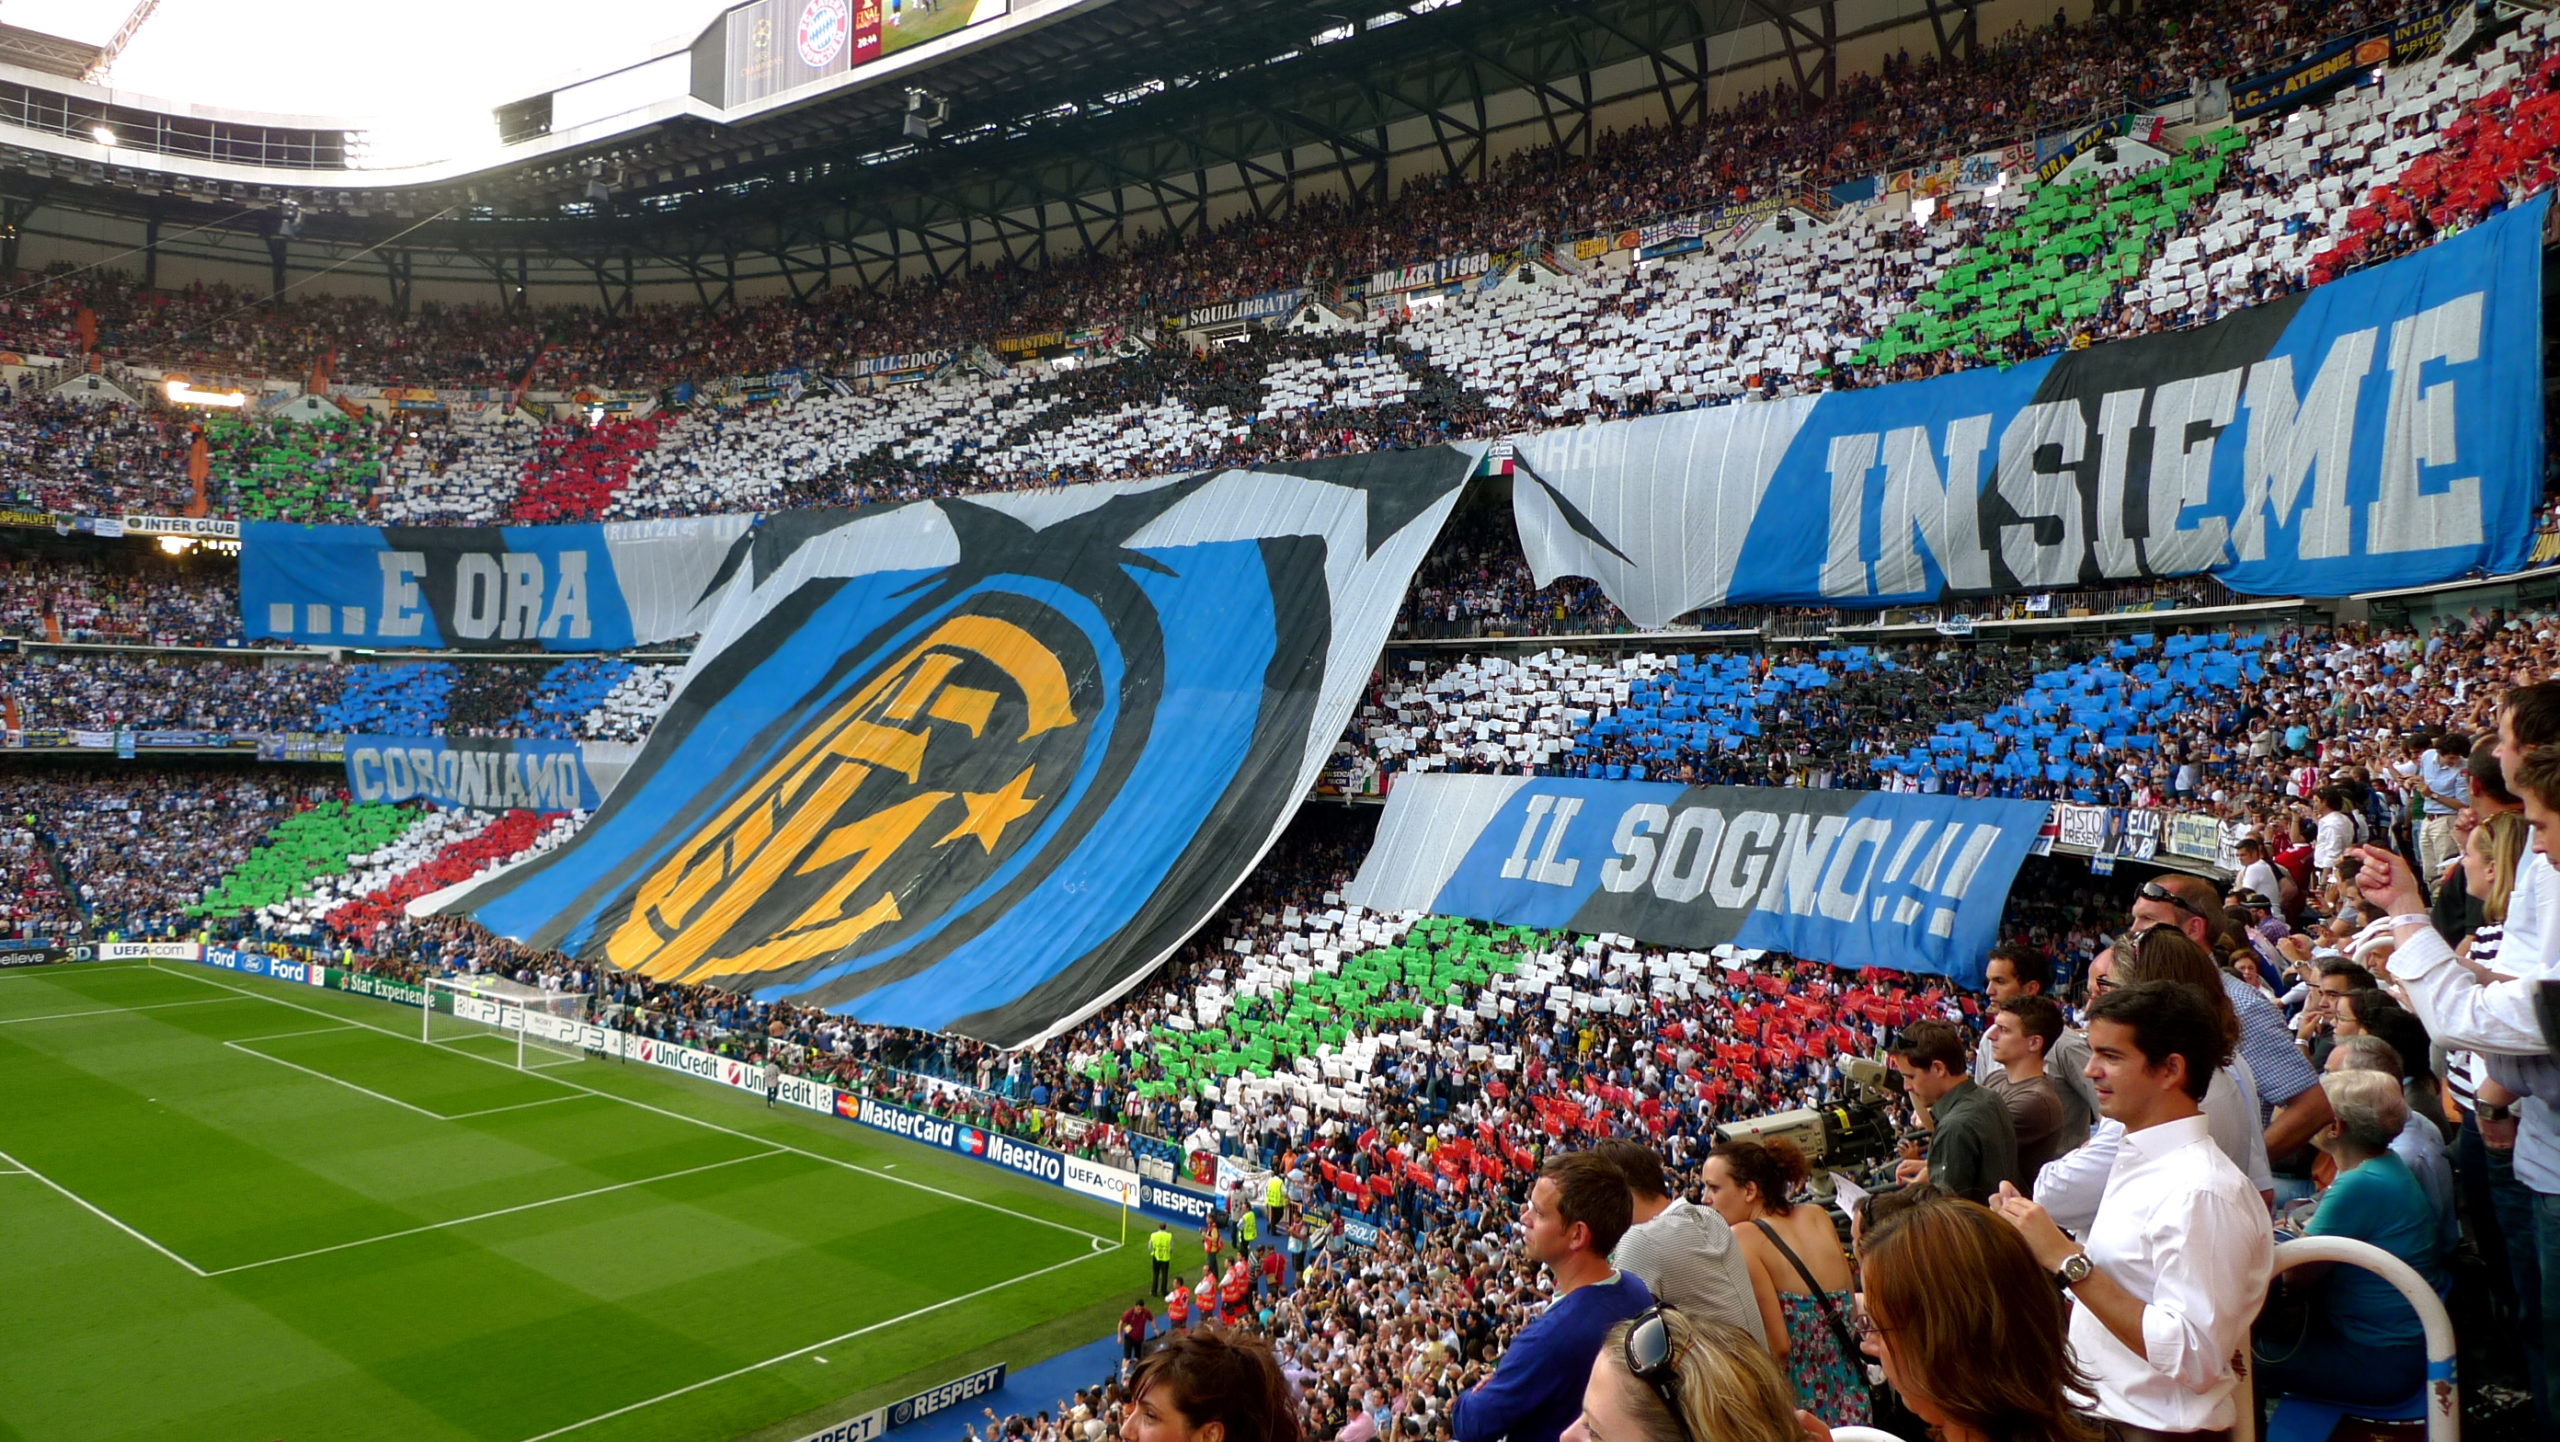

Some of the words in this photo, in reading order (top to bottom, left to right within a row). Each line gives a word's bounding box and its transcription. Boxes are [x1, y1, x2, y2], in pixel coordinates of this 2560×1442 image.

[2394, 14, 2444, 41] INTER
[2282, 53, 2353, 95] ATENE
[1451, 253, 1490, 277] 1988
[1819, 290, 2485, 597] INSIEME
[145, 518, 192, 532] INTER
[195, 518, 236, 535] CLUB
[453, 550, 592, 640] ORA
[352, 747, 581, 809] CORONIAMO
[2064, 807, 2103, 834] PISTO
[2064, 828, 2099, 845] PRESEN
[1500, 794, 1584, 887] IL
[1600, 802, 2002, 940] SOGNO!!!
[65, 946, 92, 962] 3D
[206, 946, 236, 968] Ford
[270, 960, 305, 982] Ford
[350, 973, 373, 995] Star
[560, 1020, 605, 1051] PS3
[655, 1042, 719, 1079] UniCredit
[744, 1073, 812, 1105] Uniredit
[859, 1098, 954, 1147] MasterCard
[986, 1134, 1061, 1180] Maestro
[1152, 1187, 1215, 1218] RESPECT
[913, 1368, 999, 1420] RESPECT
